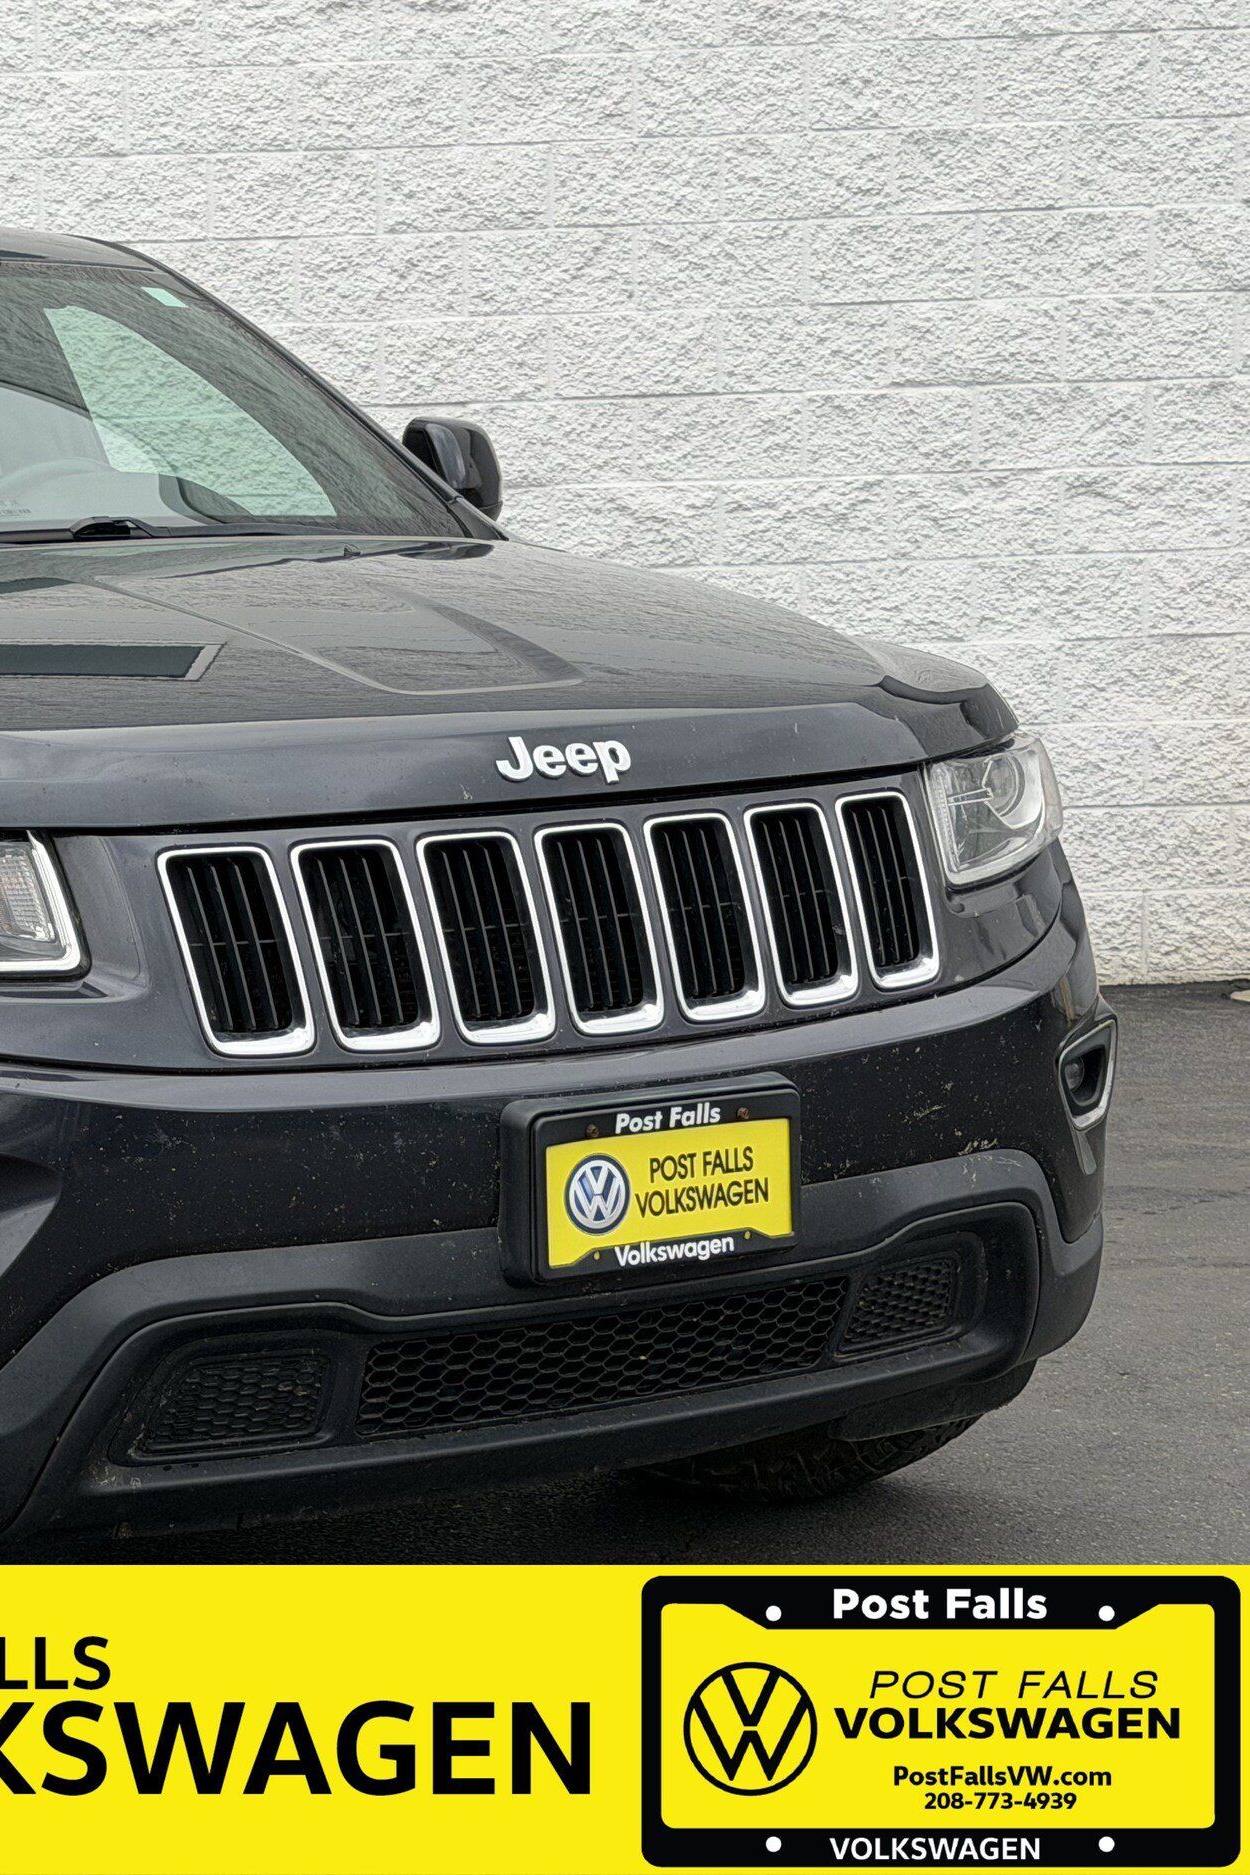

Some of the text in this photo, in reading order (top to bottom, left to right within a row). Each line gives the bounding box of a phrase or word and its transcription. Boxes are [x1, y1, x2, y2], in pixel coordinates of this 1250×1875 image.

[495, 736, 632, 785] Jeep
[614, 1102, 721, 1135] Post Falls
[649, 1145, 754, 1184] POST FALLS
[634, 1177, 769, 1219] VOLKSWAGEN
[614, 1236, 734, 1268] Volkswagen
